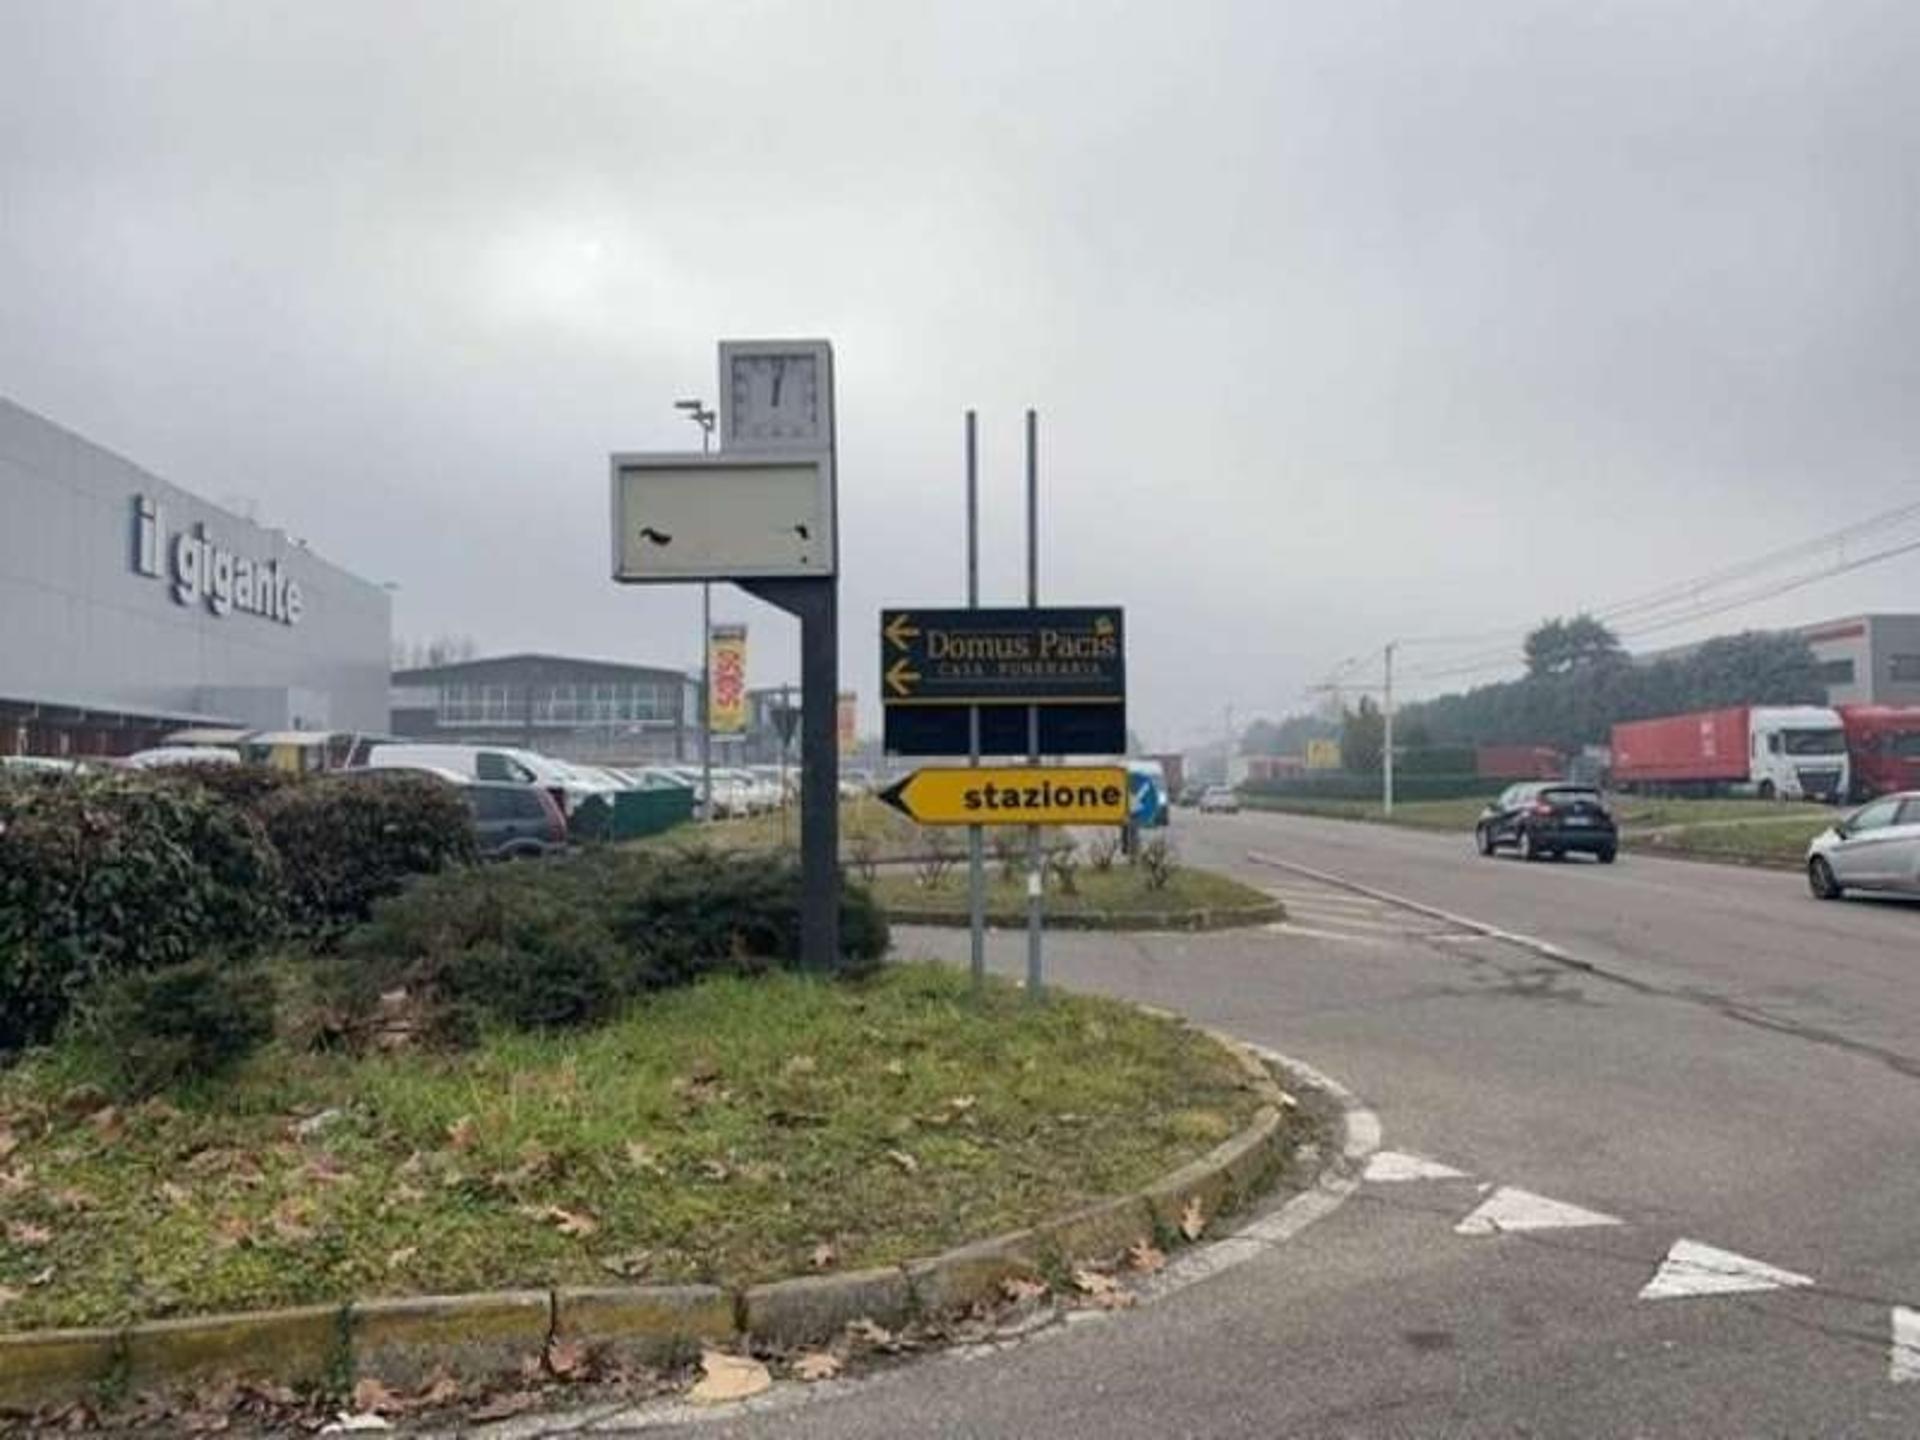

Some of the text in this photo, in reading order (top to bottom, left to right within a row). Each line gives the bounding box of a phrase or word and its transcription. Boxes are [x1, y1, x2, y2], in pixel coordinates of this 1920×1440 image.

[132, 494, 302, 627] il gigante
[926, 629, 1117, 659] Domus Pacis
[963, 781, 1122, 811] stazione
